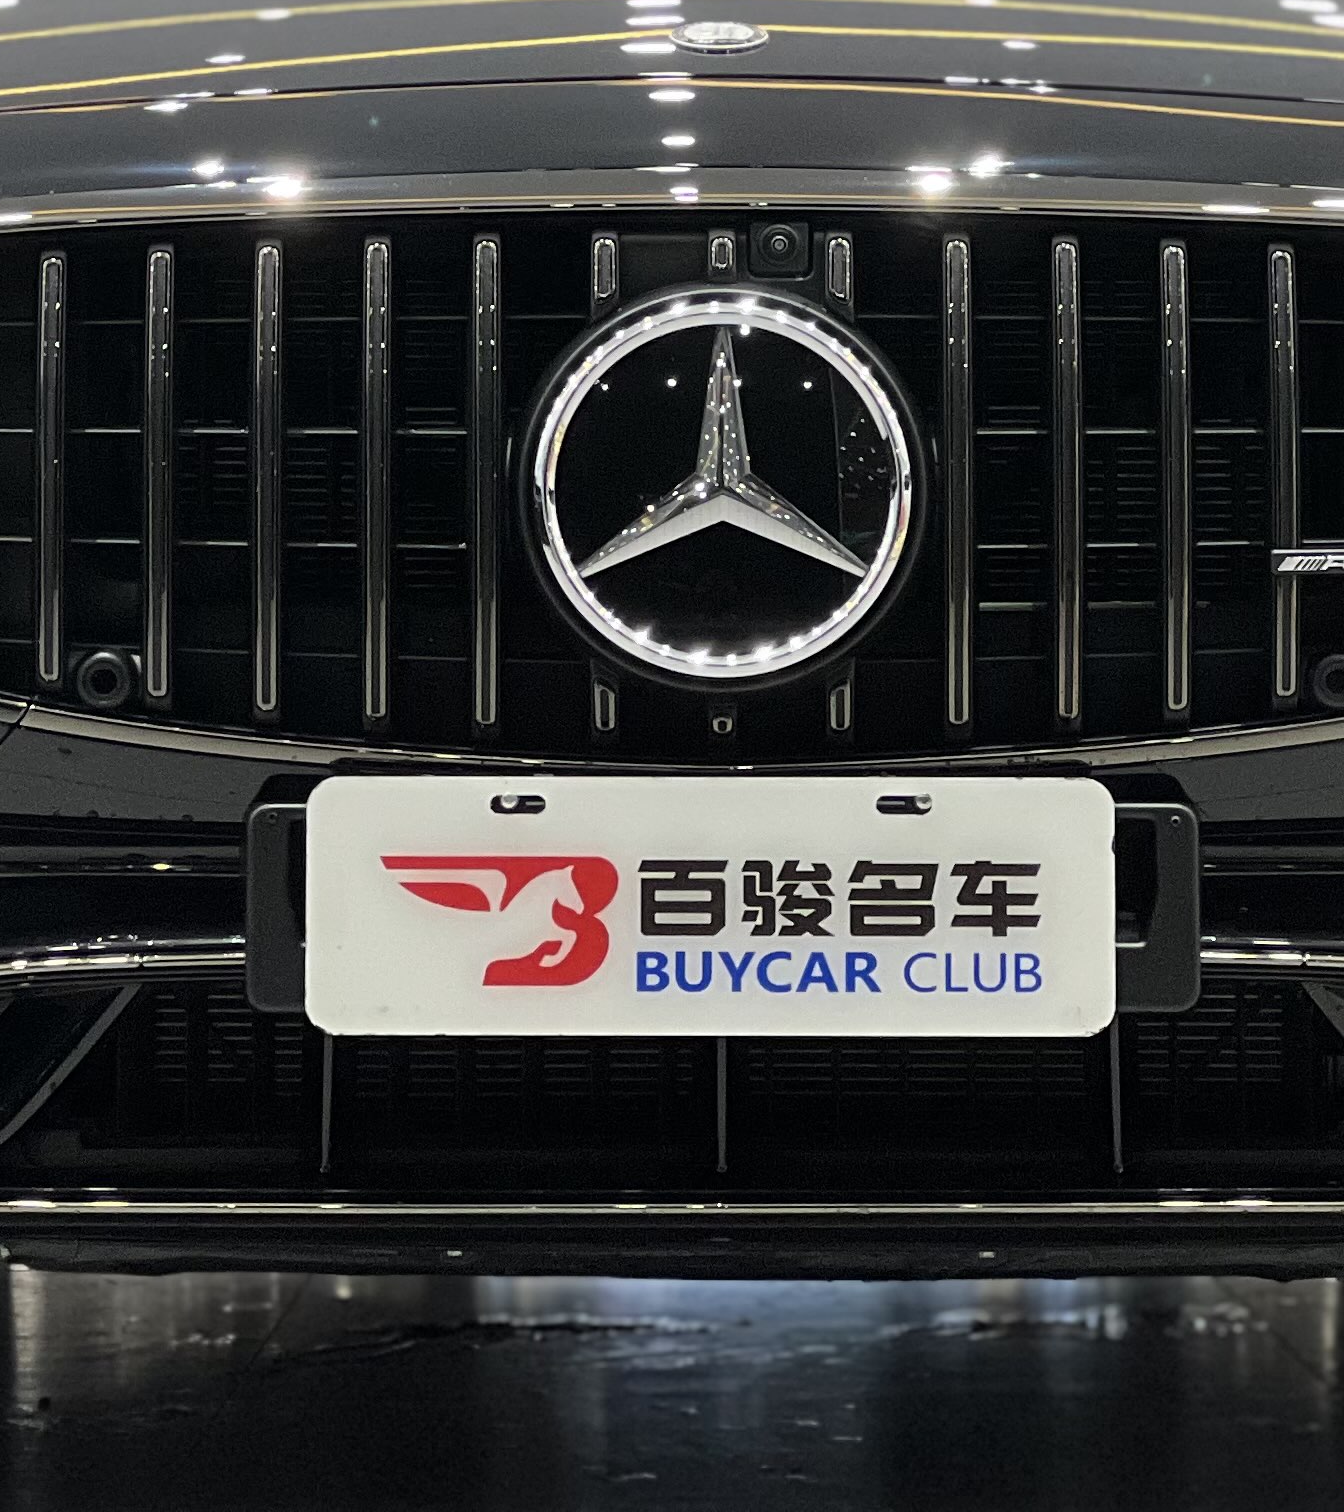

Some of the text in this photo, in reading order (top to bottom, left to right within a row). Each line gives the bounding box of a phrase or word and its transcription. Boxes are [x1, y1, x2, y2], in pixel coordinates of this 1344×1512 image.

[638, 860, 1042, 937] 百骏名车
[637, 951, 1042, 993] BUYCAR CLUB
